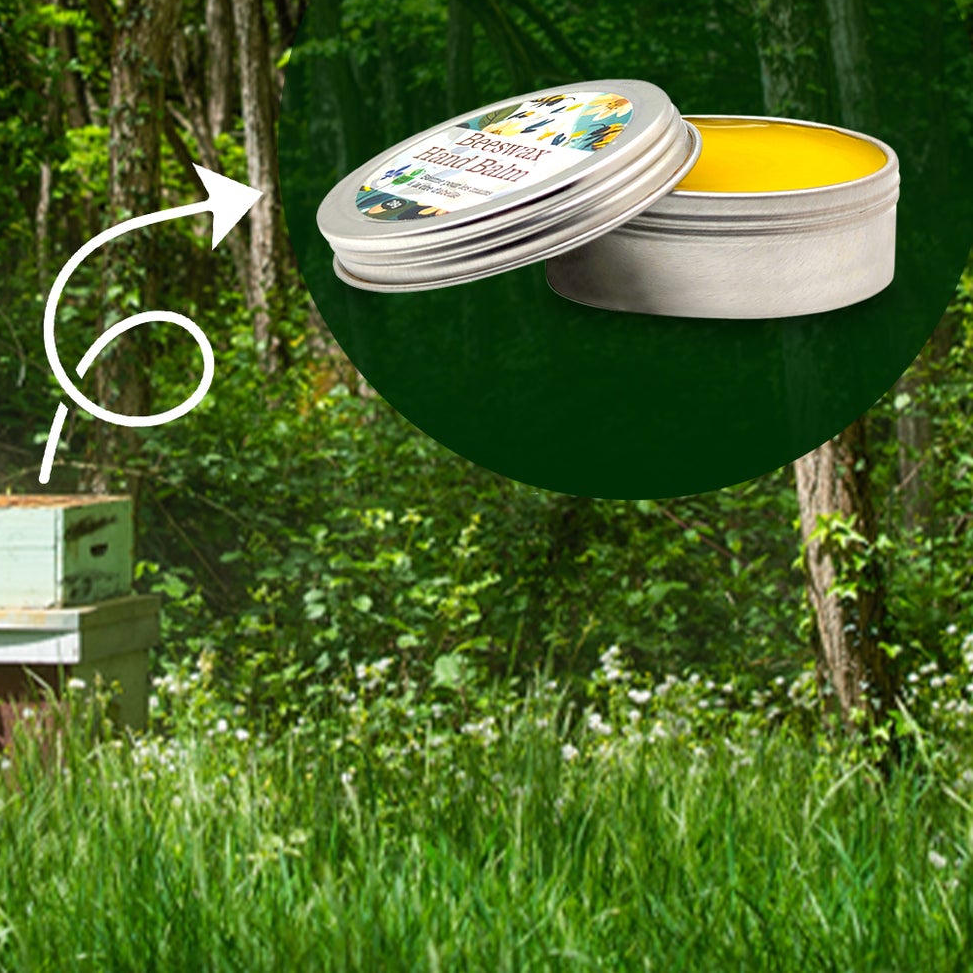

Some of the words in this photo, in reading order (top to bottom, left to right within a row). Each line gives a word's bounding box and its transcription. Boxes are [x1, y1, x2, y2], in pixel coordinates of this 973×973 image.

[455, 132, 552, 162] Beeswax
[413, 146, 479, 170] Hand
[465, 158, 529, 183] Balm
